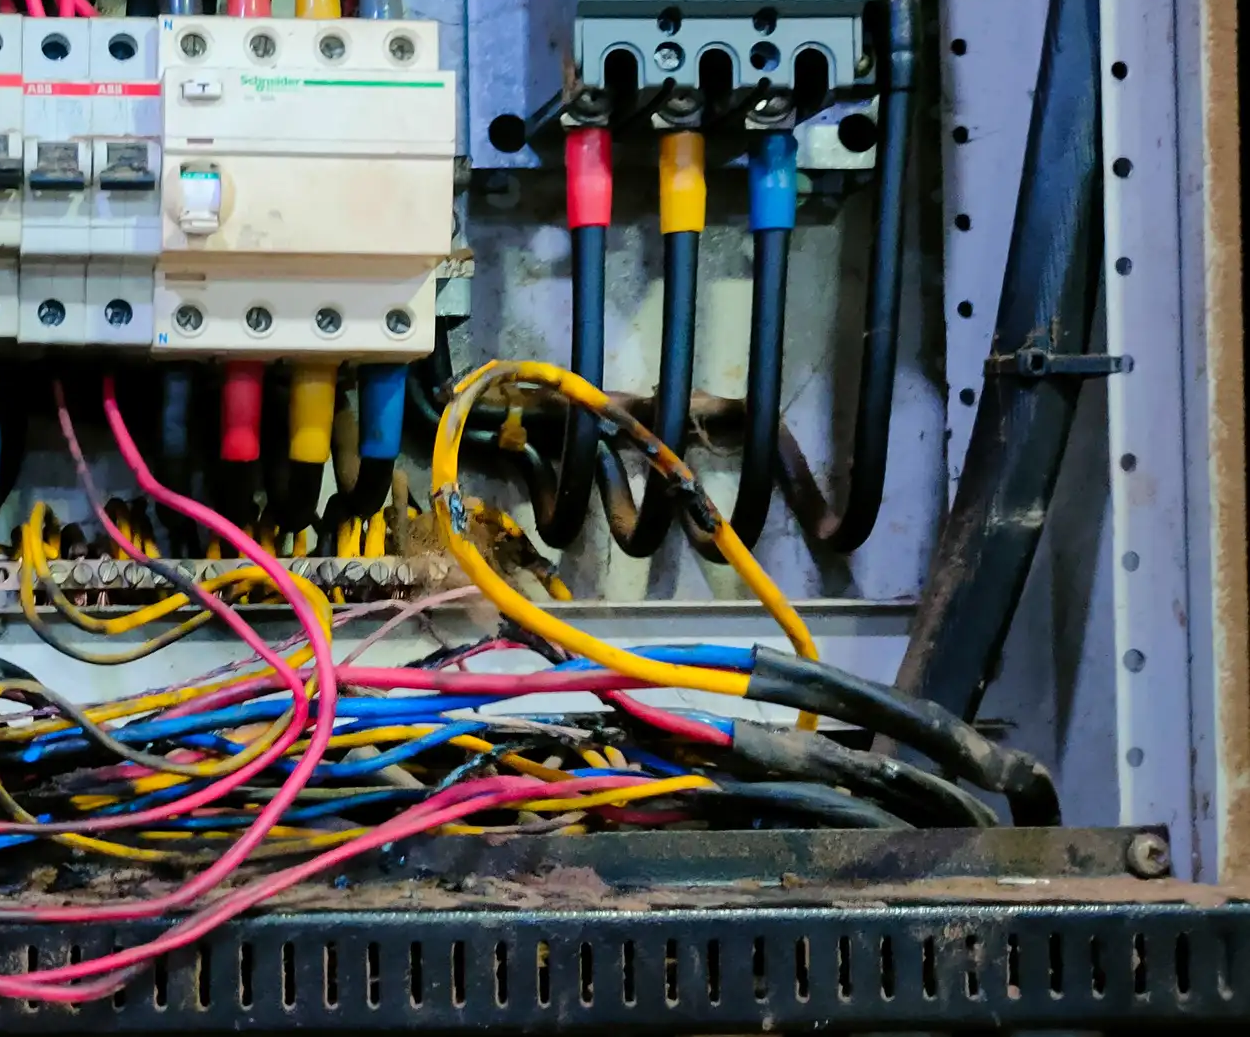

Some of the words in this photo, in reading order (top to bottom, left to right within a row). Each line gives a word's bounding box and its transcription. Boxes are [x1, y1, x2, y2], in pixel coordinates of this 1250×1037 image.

[164, 19, 173, 30] N
[197, 83, 210, 93] T
[240, 75, 300, 92] Schneider
[27, 85, 52, 95] ABB
[97, 85, 122, 95] ABB
[159, 333, 168, 344] N
